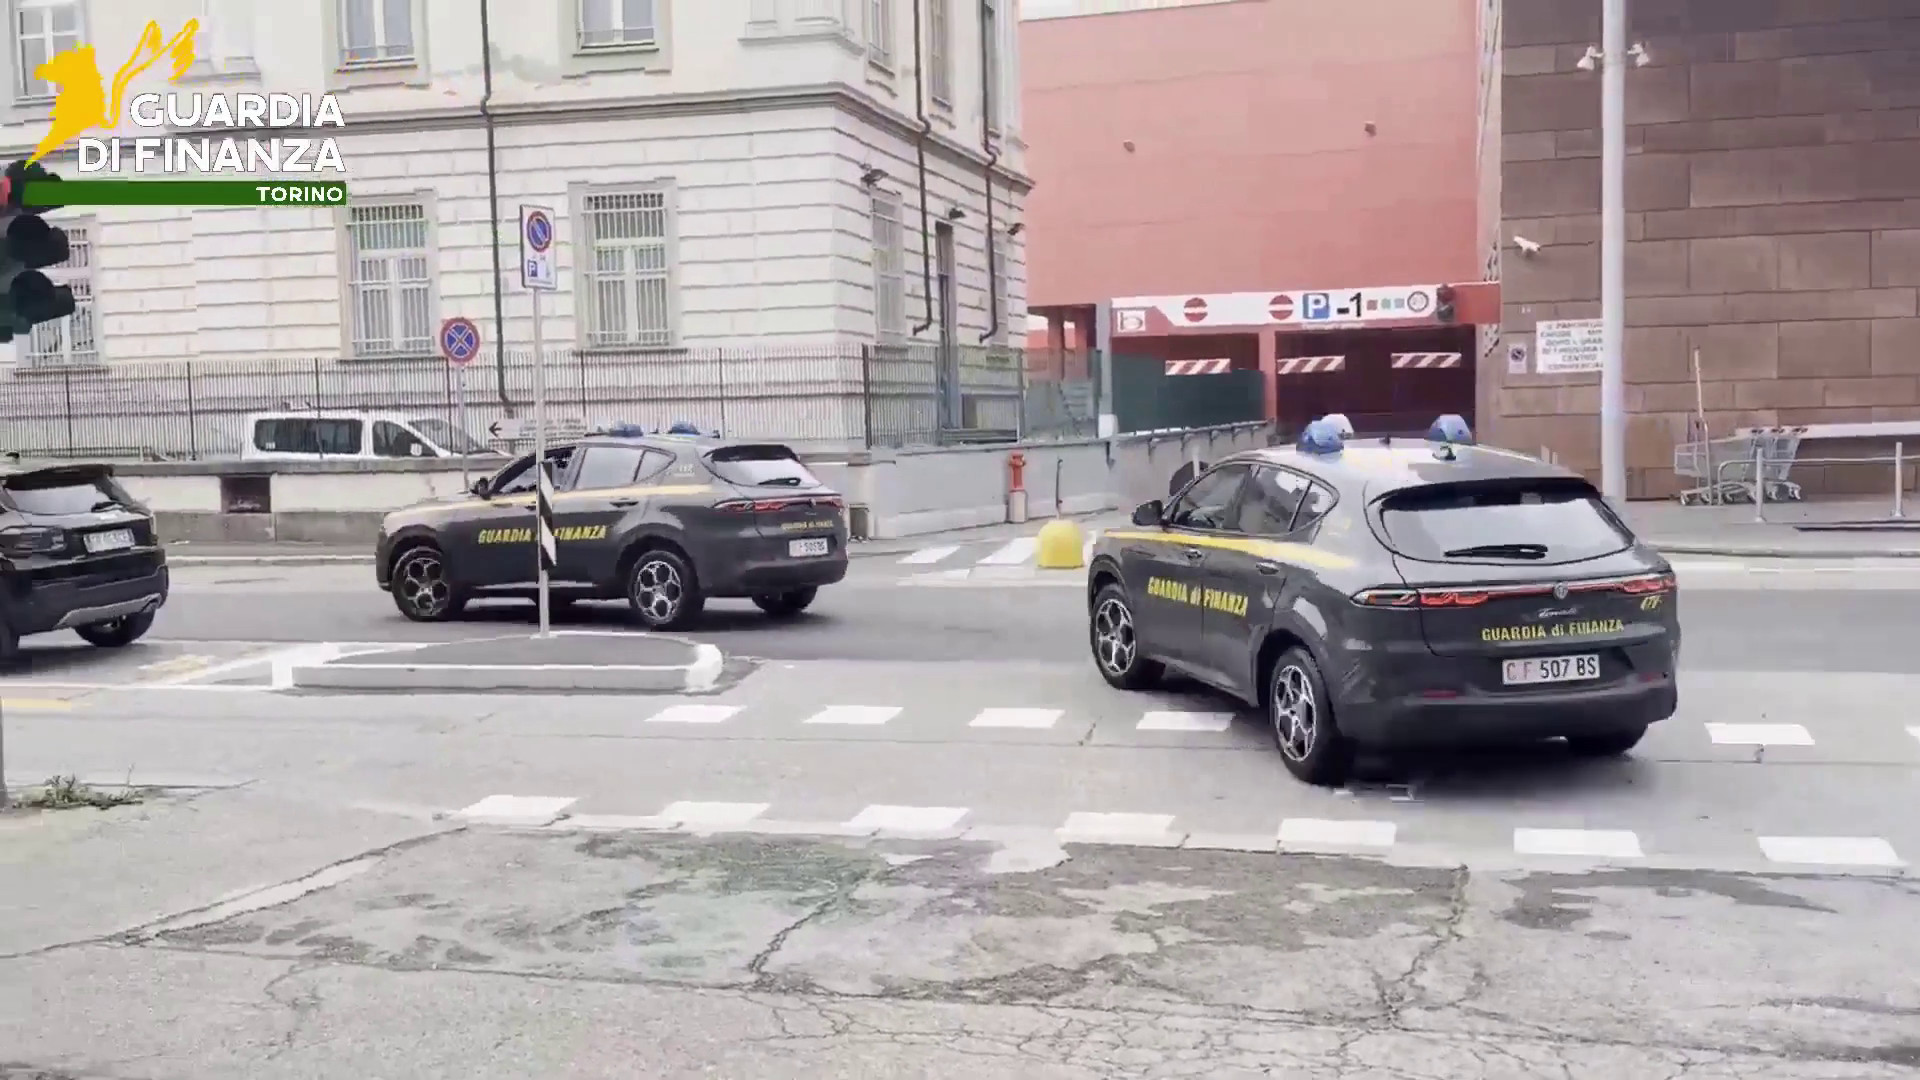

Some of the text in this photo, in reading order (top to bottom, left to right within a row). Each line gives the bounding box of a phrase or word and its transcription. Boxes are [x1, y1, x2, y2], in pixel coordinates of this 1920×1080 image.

[1308, 292, 1361, 318] P -1
[478, 528, 532, 544] GUARDIA
[1148, 576, 1249, 617] GUARDIA di FINANZA
[1482, 619, 1625, 641] GUARDIA di FINANZA
[1540, 659, 1570, 679] 507
[1576, 656, 1597, 676] BS
